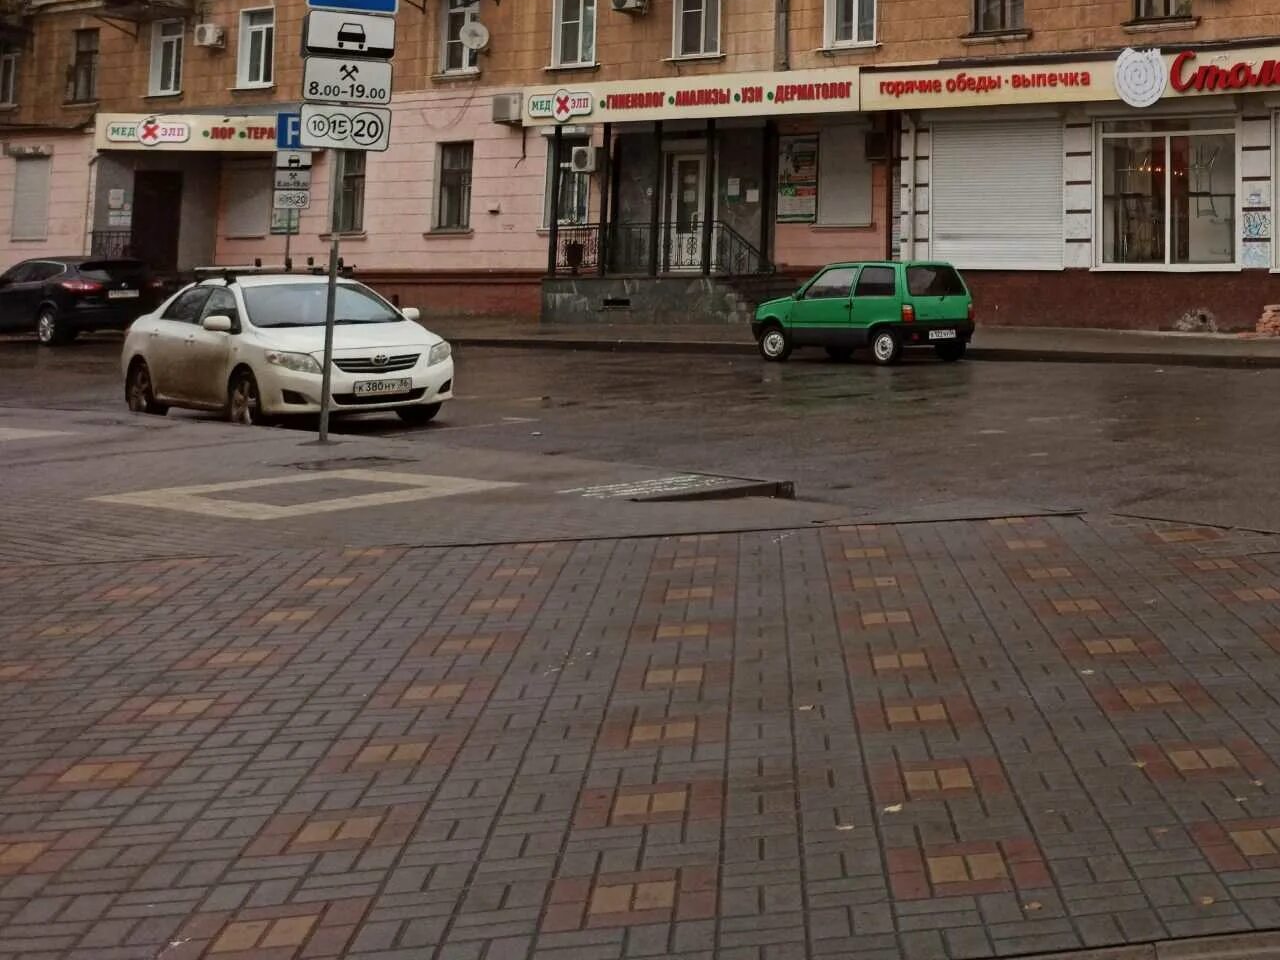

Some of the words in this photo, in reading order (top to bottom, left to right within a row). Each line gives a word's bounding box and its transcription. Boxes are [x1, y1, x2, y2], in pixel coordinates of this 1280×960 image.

[308, 81, 386, 100] 8.00-19.00
[879, 77, 942, 99] горячие
[945, 72, 1001, 93] обеды
[1011, 70, 1091, 89] выпечка
[605, 91, 665, 109] ГИНЕКОЛОГ
[674, 87, 731, 106] АНАЛИЗЫ
[740, 85, 763, 103] УЗИ
[773, 81, 852, 102] ДЕРМАТОЛОГ
[210, 126, 235, 140] ЛОР
[246, 126, 275, 140] ТЕРА
[312, 119, 325, 132] 10
[330, 119, 348, 135] 15
[353, 119, 378, 139] 20
